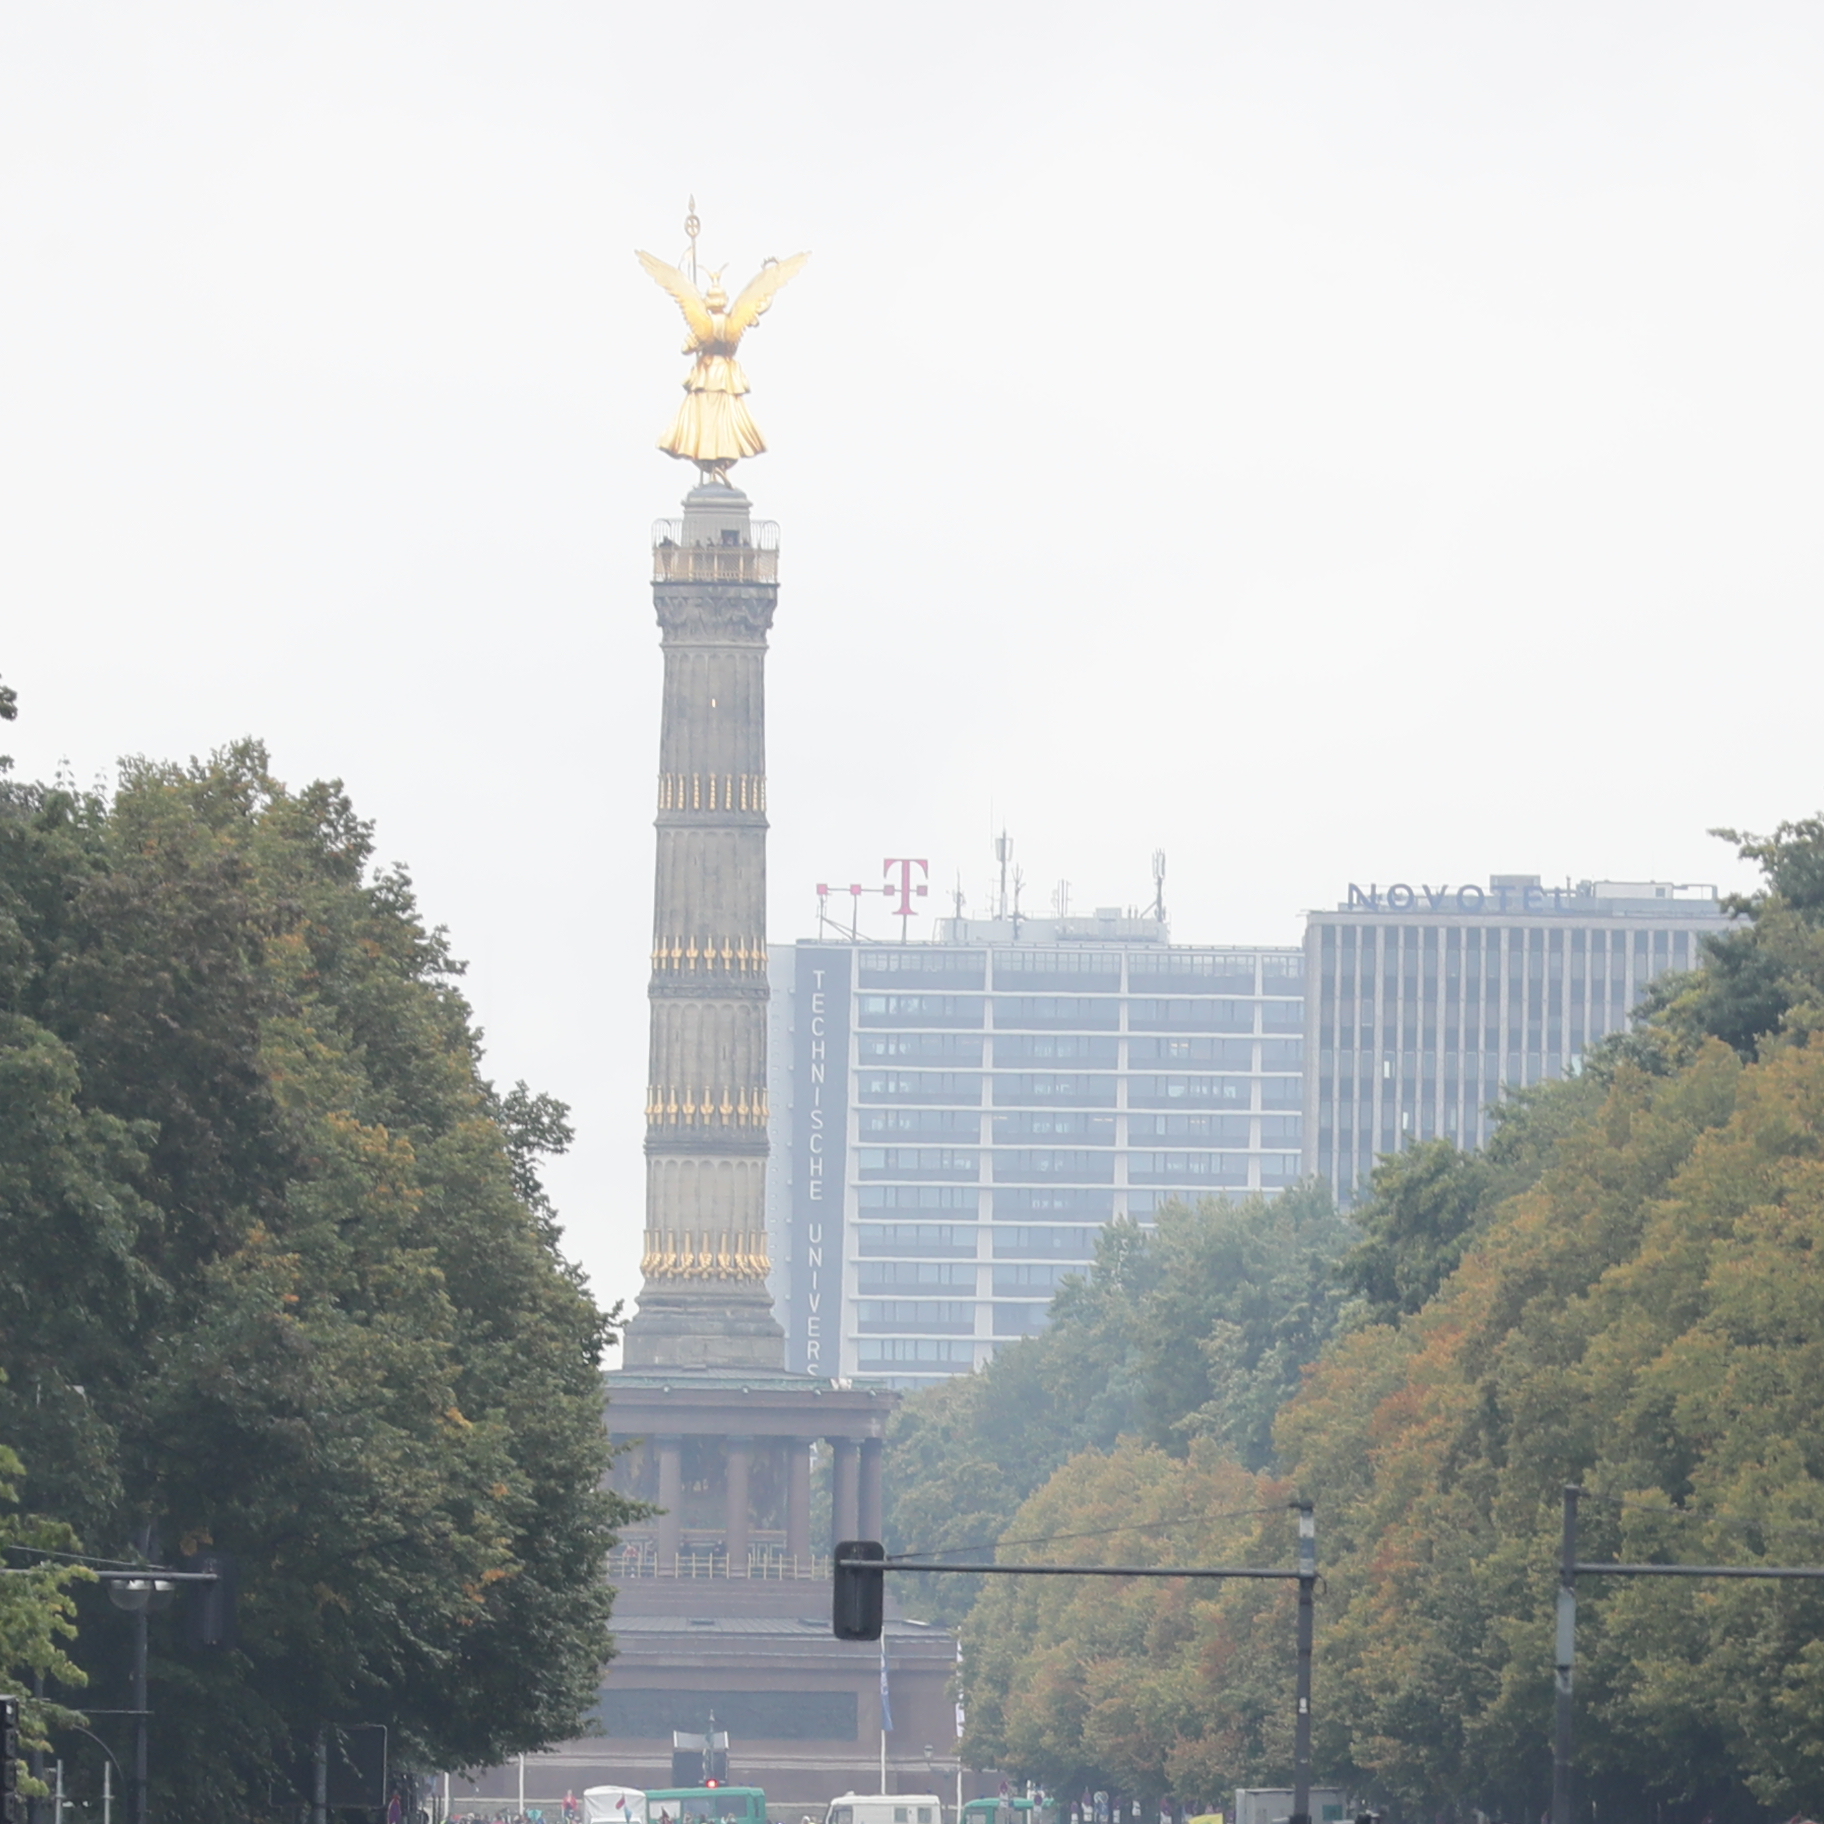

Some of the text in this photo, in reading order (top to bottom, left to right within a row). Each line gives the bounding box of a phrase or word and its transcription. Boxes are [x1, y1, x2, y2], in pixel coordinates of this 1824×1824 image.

[883, 858, 928, 916] T
[1347, 881, 1578, 914] NOVOTEL
[808, 969, 826, 1200] TECHNISCHE
